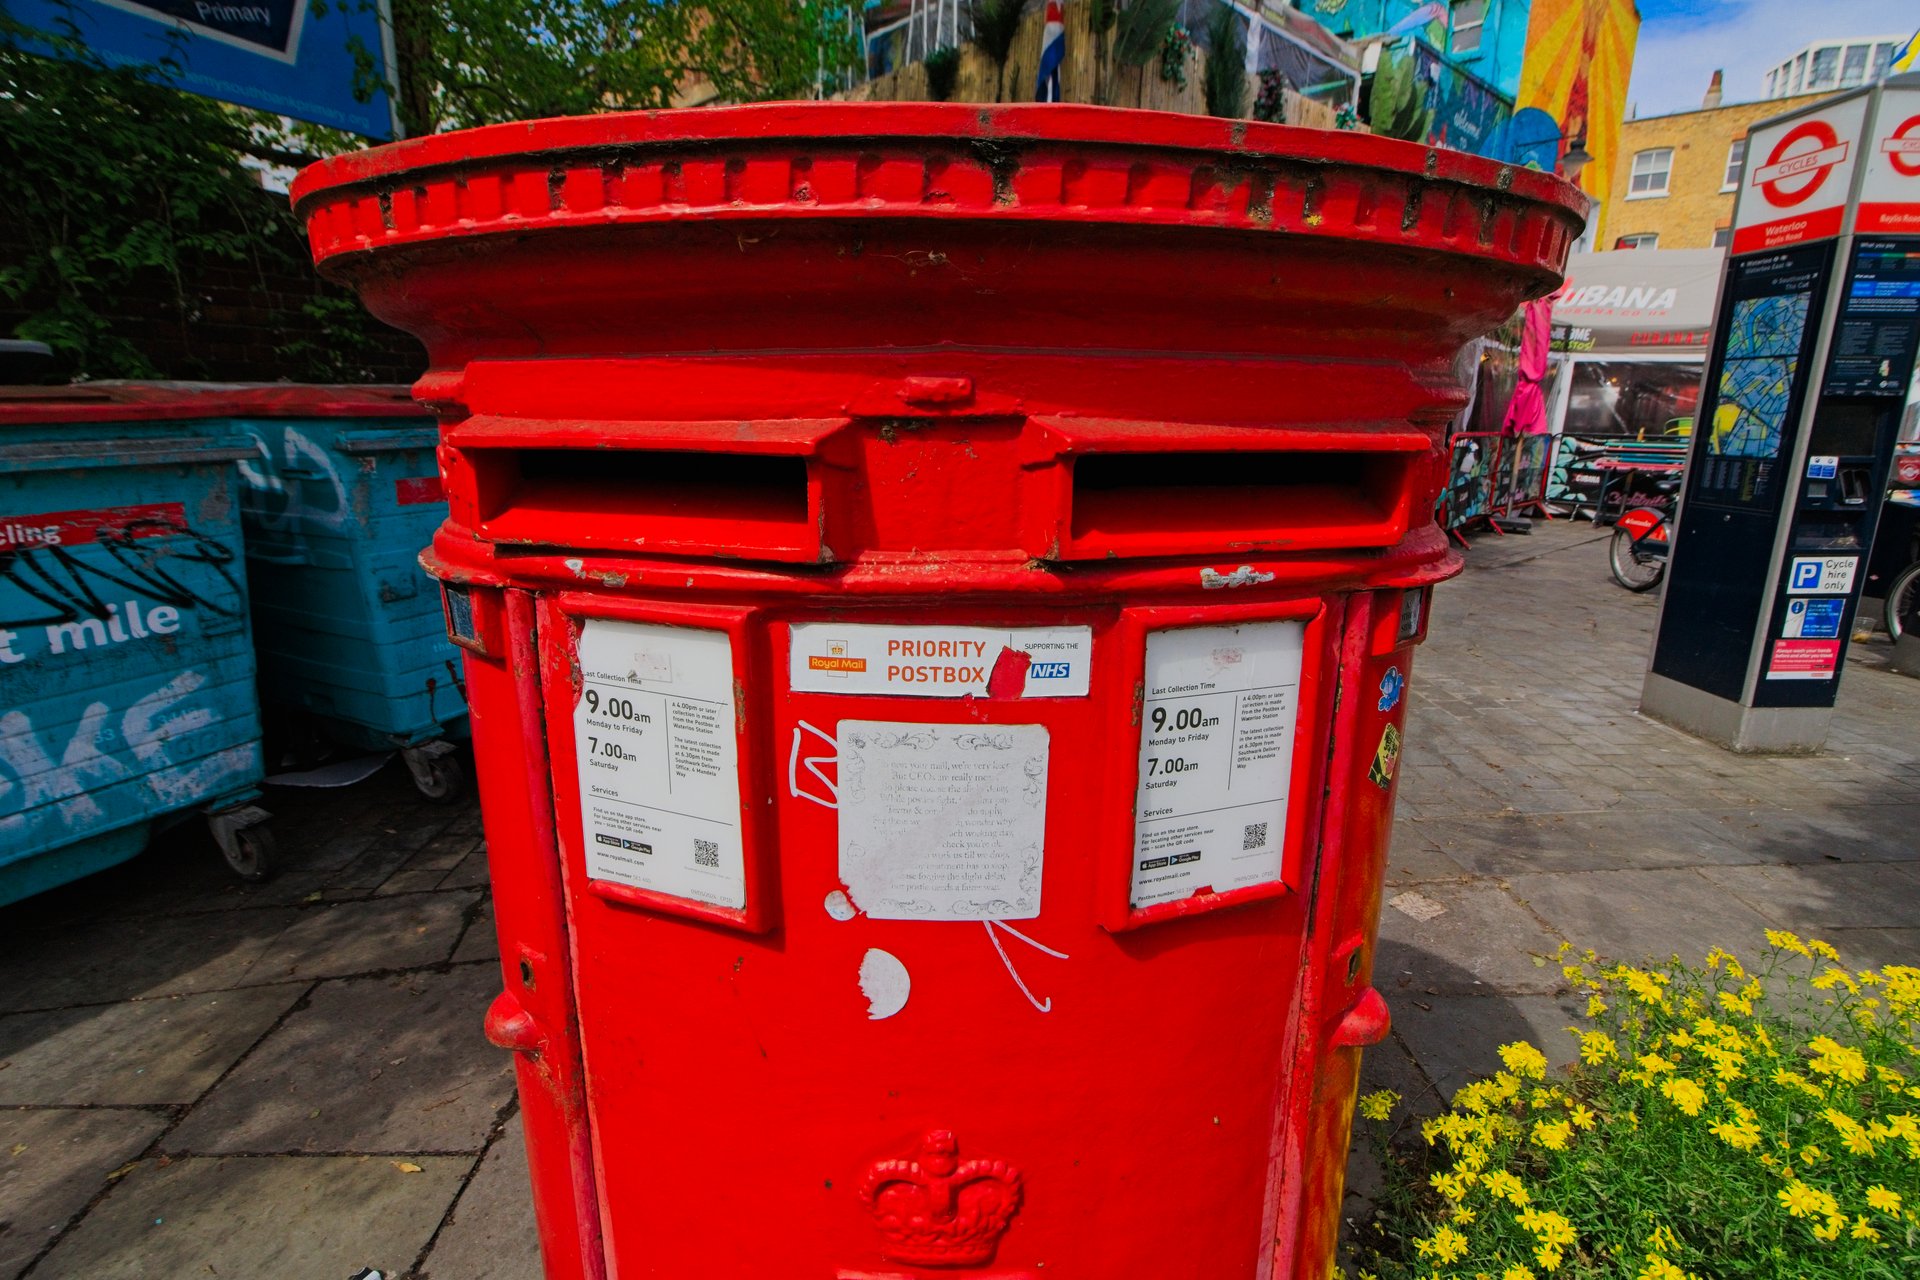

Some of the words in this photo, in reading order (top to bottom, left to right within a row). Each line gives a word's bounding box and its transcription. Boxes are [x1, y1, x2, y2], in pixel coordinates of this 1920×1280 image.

[197, 0, 271, 27] Primary
[1779, 156, 1818, 175] CYCLES
[1765, 221, 1807, 237] Waterloo
[1785, 231, 1803, 243] Road
[1825, 559, 1854, 570] Cycle
[1796, 564, 1817, 586] P
[1827, 570, 1847, 579] hire
[1824, 580, 1846, 591] only
[45, 600, 181, 655] mile
[887, 639, 986, 658] PRIORITY
[1024, 643, 1065, 651] SUPPORTING
[1066, 642, 1079, 650] THE
[811, 657, 838, 670] Royal
[841, 659, 864, 670] Mail
[887, 665, 985, 684] POSTBOX
[1032, 664, 1068, 678] NHS
[597, 671, 626, 683] Collection
[627, 677, 642, 685] Time
[1167, 684, 1199, 693] Collection
[1200, 682, 1215, 690] Time
[585, 689, 651, 723] 9.00am
[677, 702, 698, 711] 4.00pm
[673, 709, 695, 717] collection
[587, 718, 612, 732] Monday
[622, 724, 643, 736] Friday
[673, 723, 694, 731] Waterloo
[1151, 707, 1219, 734] 9.00am
[699, 741, 721, 750] collection
[1149, 736, 1177, 747] Monday
[1187, 732, 1210, 742] Friday
[588, 736, 637, 762] 7.00am
[1238, 748, 1262, 756] Southwark
[589, 758, 619, 771] Saturday
[675, 757, 700, 766] Southwark
[701, 762, 721, 771] Delivery
[1147, 757, 1199, 776] 7.00am
[697, 768, 717, 776] Mandela
[591, 785, 619, 797] Services
[1145, 779, 1178, 790] Saturday
[1143, 806, 1173, 818] Services
[602, 815, 620, 824] locating
[942, 839, 964, 848] check
[1151, 836, 1169, 844] locating
[597, 851, 645, 866] www.royalmail.com
[616, 871, 632, 879] number
[1139, 871, 1191, 885] www.royalmail.com
